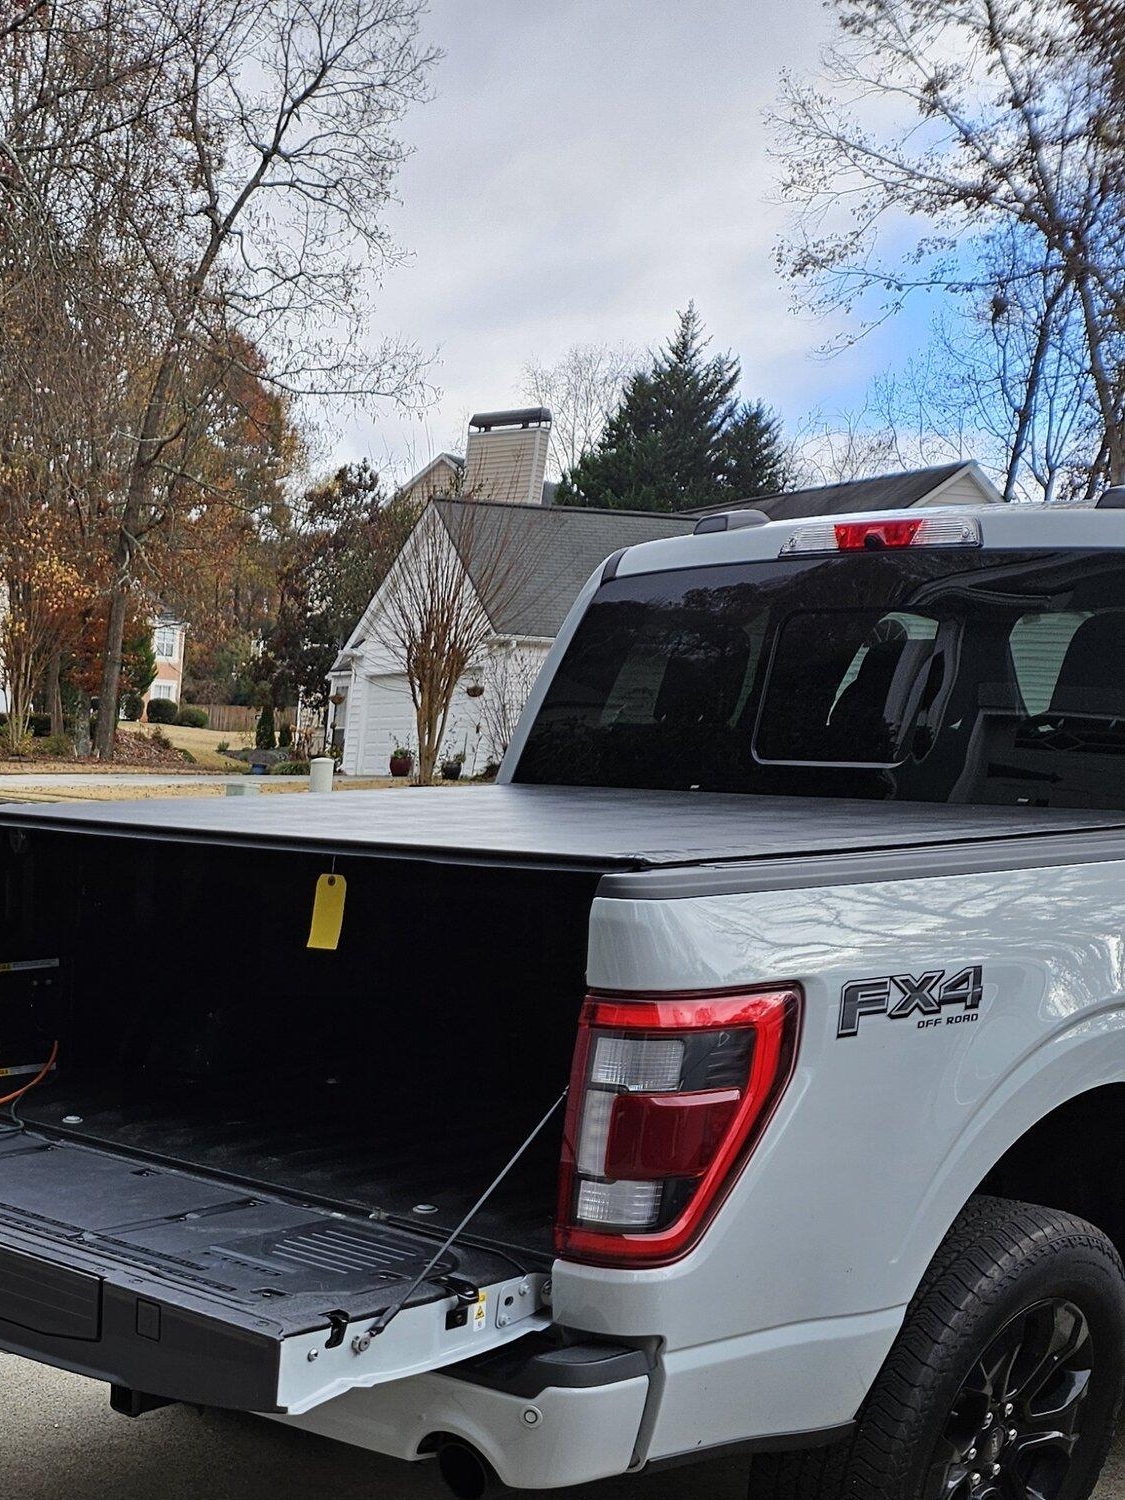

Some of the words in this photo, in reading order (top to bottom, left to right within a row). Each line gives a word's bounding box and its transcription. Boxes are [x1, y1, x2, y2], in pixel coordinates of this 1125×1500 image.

[836, 965, 982, 1039] FX4
[917, 1018, 942, 1028] OFF
[946, 1014, 978, 1025] ROAD
